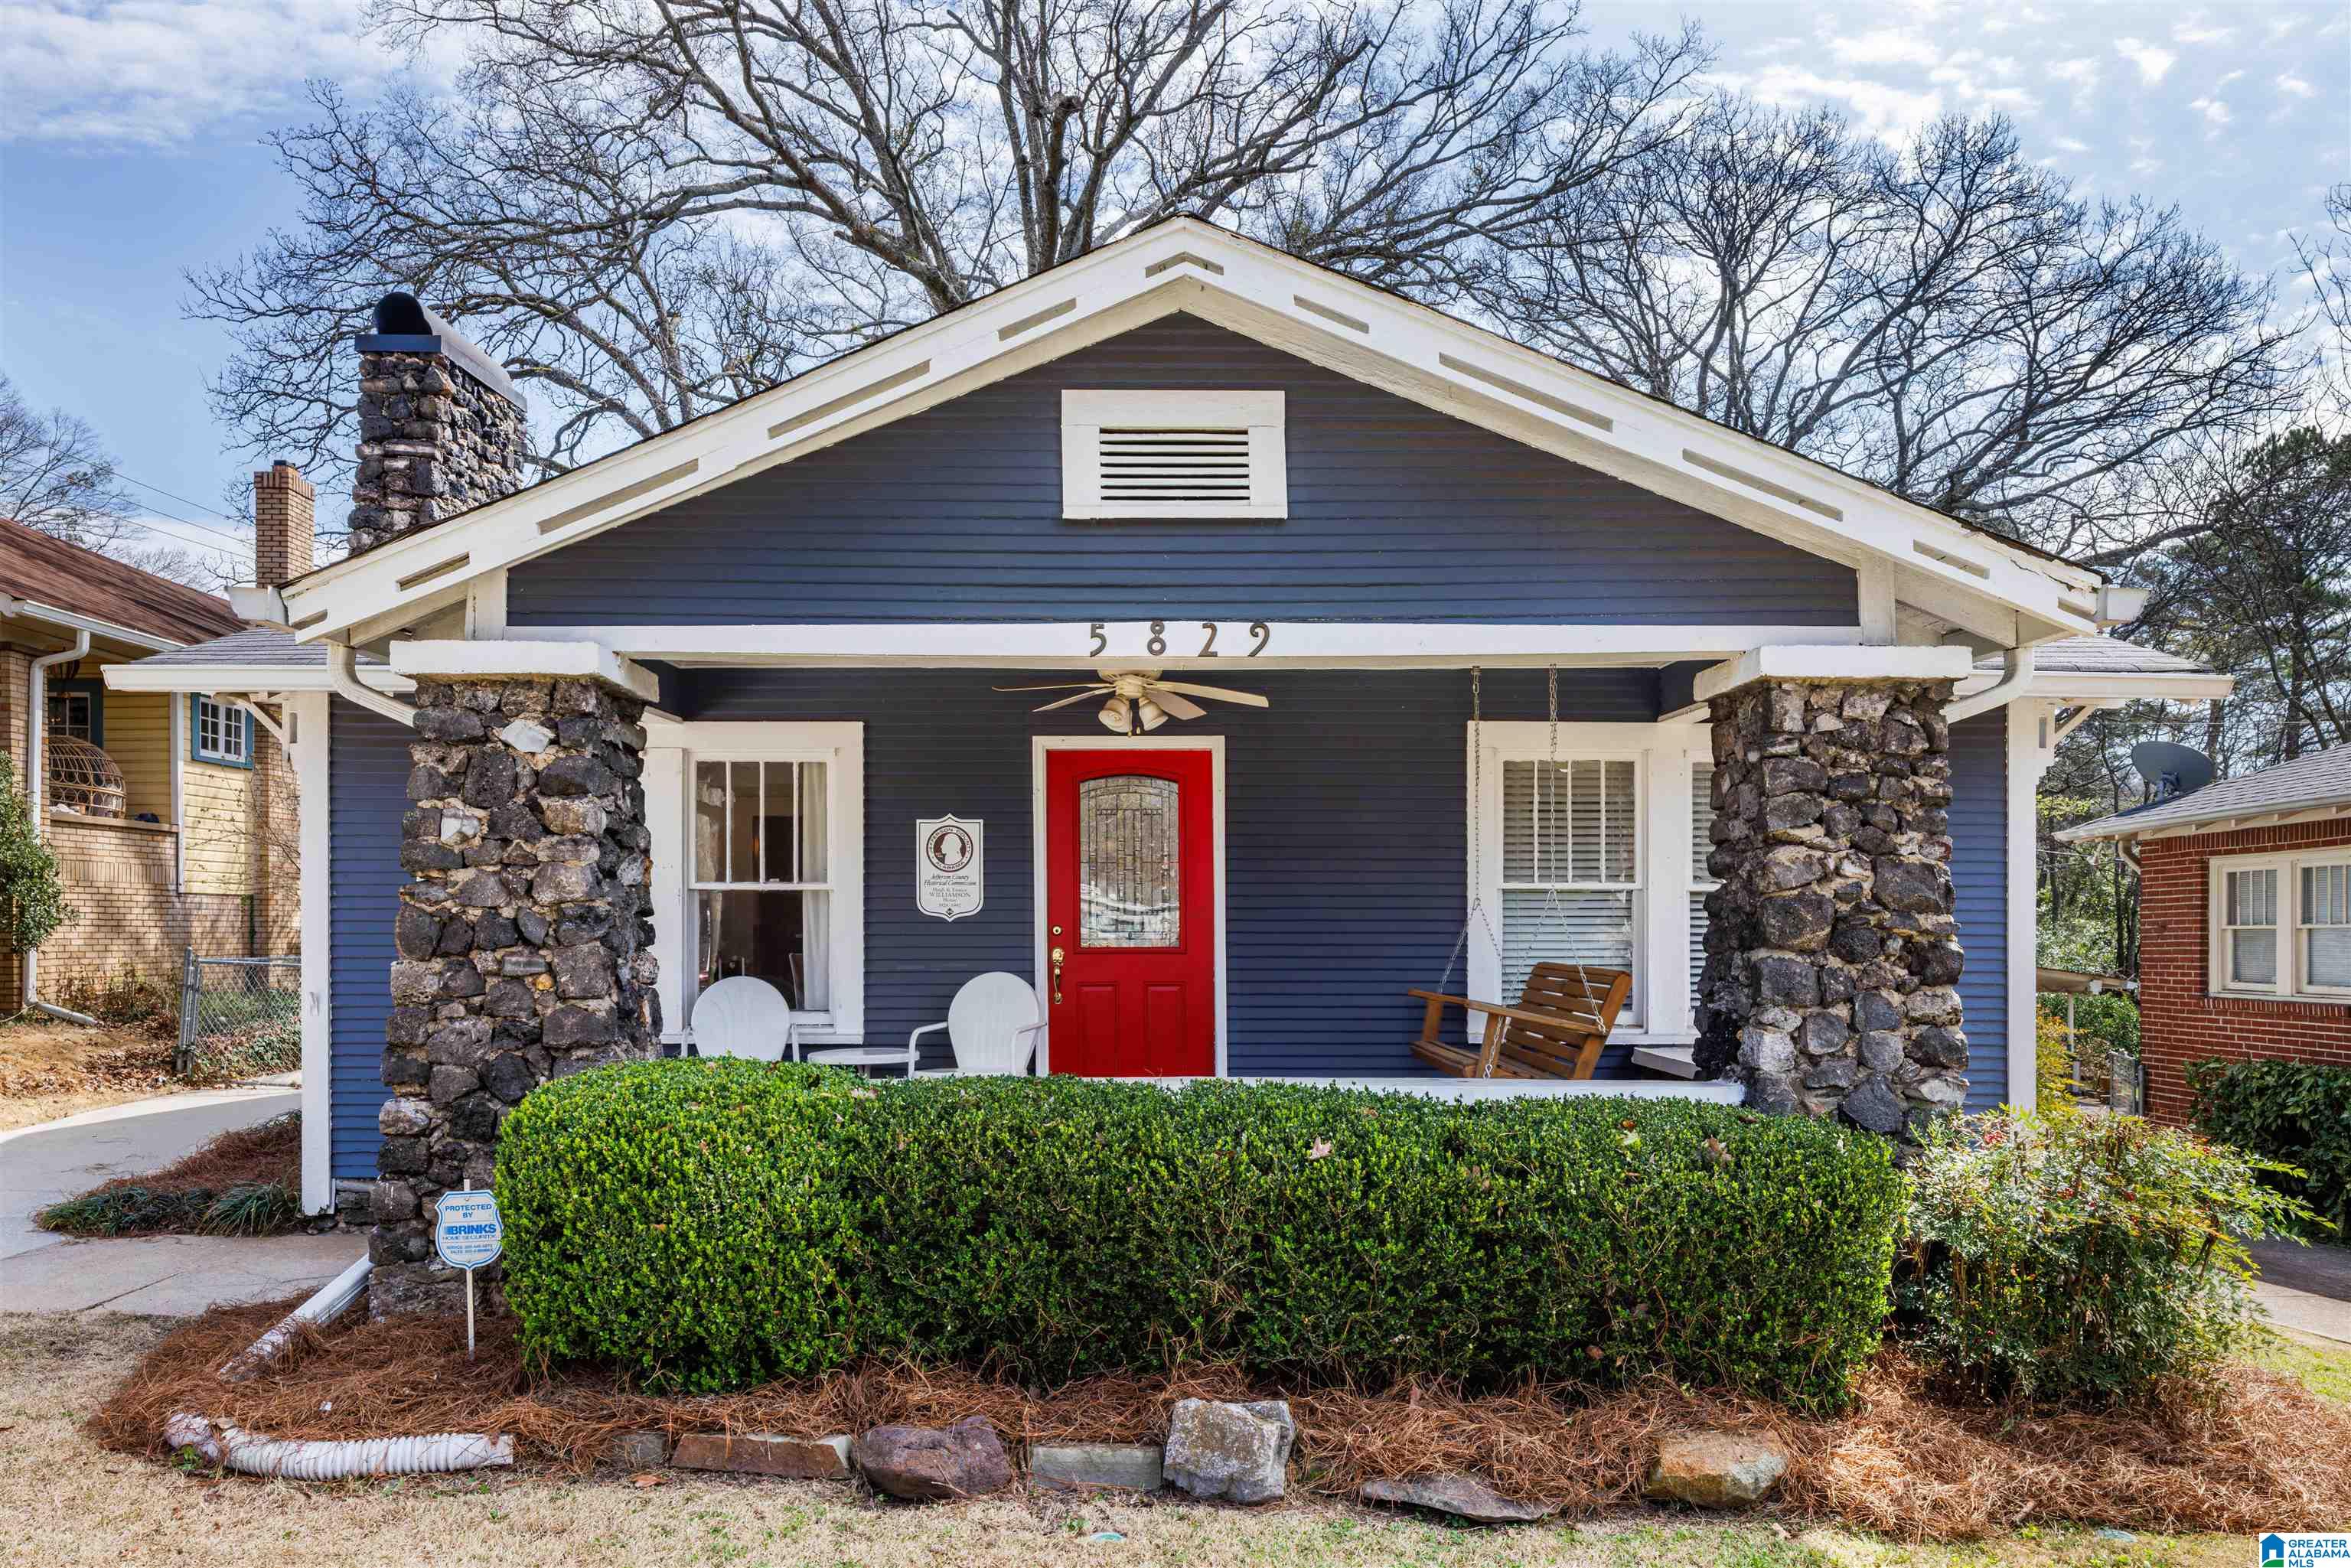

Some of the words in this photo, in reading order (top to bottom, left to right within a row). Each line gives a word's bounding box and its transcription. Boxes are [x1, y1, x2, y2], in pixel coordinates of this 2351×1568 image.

[1089, 620, 1270, 658] 5829
[935, 861, 965, 870] ALABAMA
[450, 1224, 497, 1235] BRINKS
